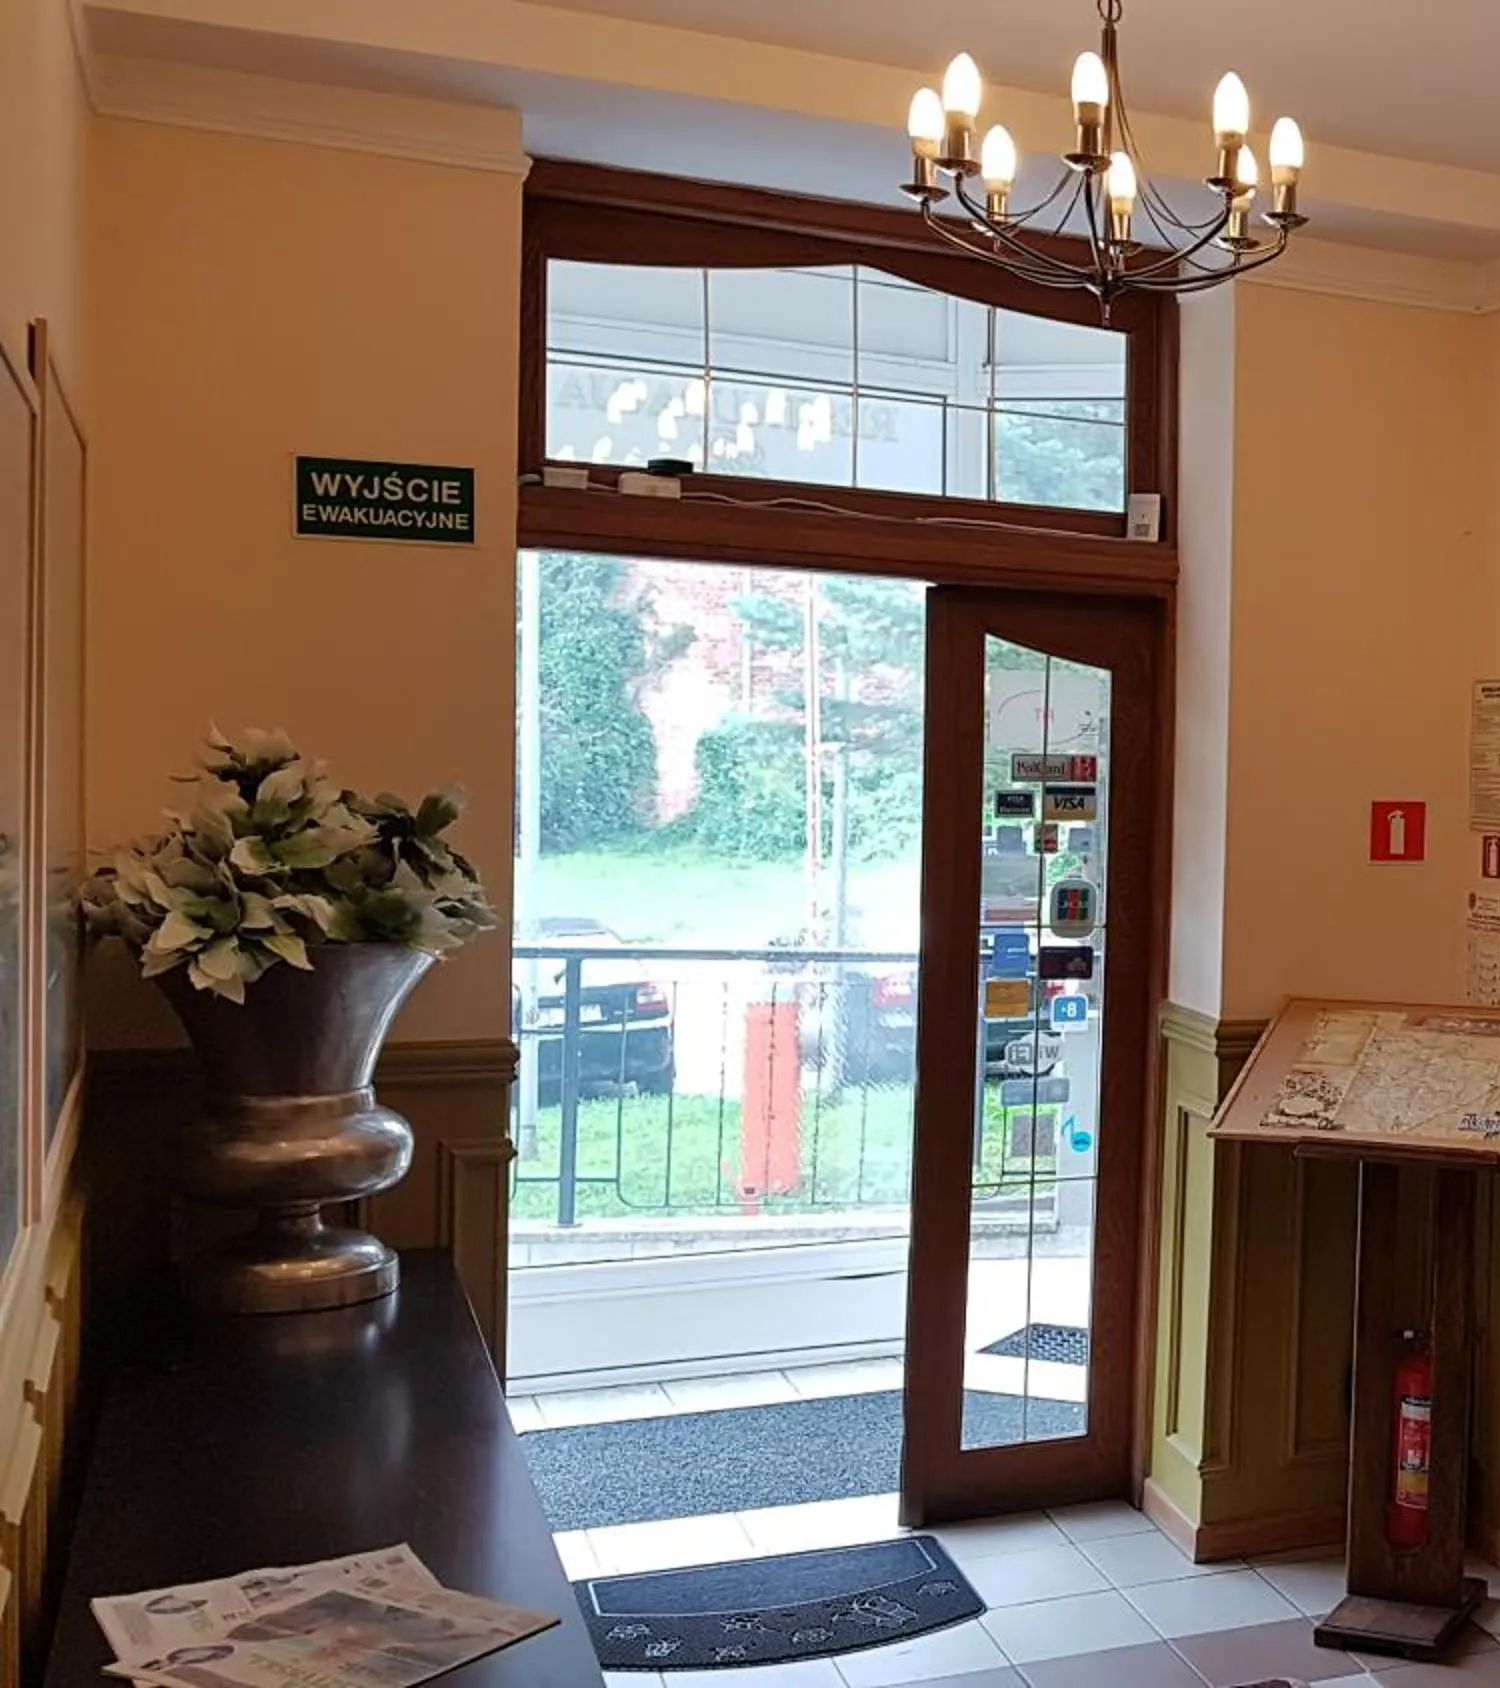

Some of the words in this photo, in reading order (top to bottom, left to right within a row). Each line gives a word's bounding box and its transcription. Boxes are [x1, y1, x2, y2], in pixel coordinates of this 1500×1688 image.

[311, 470, 462, 505] WYJŚCIE
[302, 503, 470, 531] EWAKUACYJNE
[1053, 795, 1086, 811] VISA
